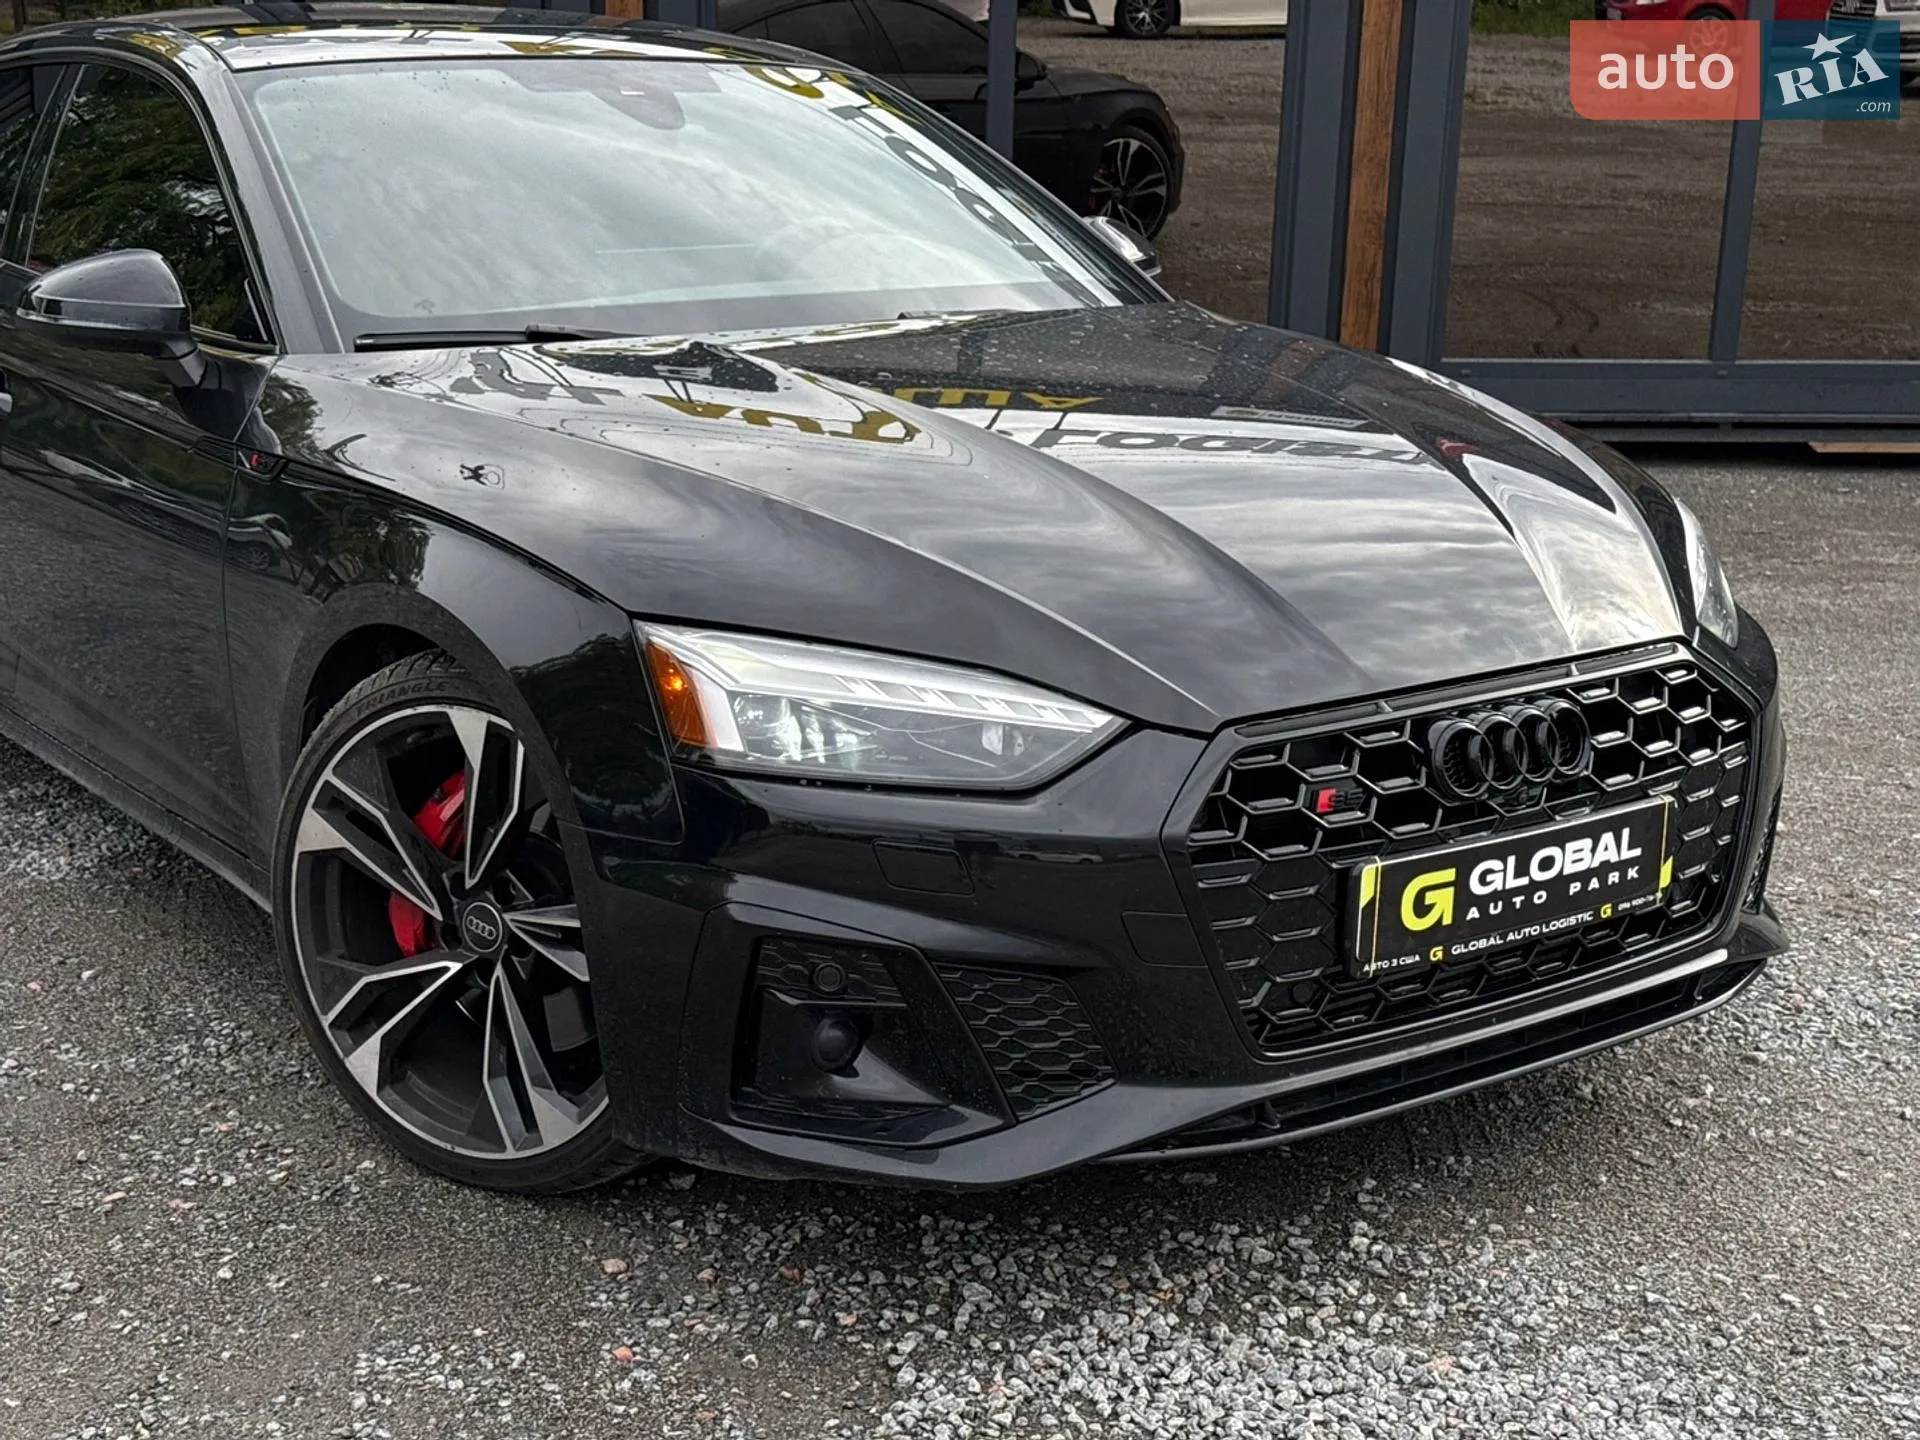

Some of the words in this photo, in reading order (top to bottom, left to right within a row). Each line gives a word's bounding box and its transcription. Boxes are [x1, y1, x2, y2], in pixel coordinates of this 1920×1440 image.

[354, 680, 450, 717] TRIANGLE
[1469, 827, 1642, 896] GLOBAL
[1465, 889, 1547, 921] AUTO
[1569, 865, 1640, 896] PARK
[1451, 935, 1504, 955] GLOBAL
[1506, 925, 1541, 942] AUTO
[1542, 910, 1594, 933] LOGISTIC
